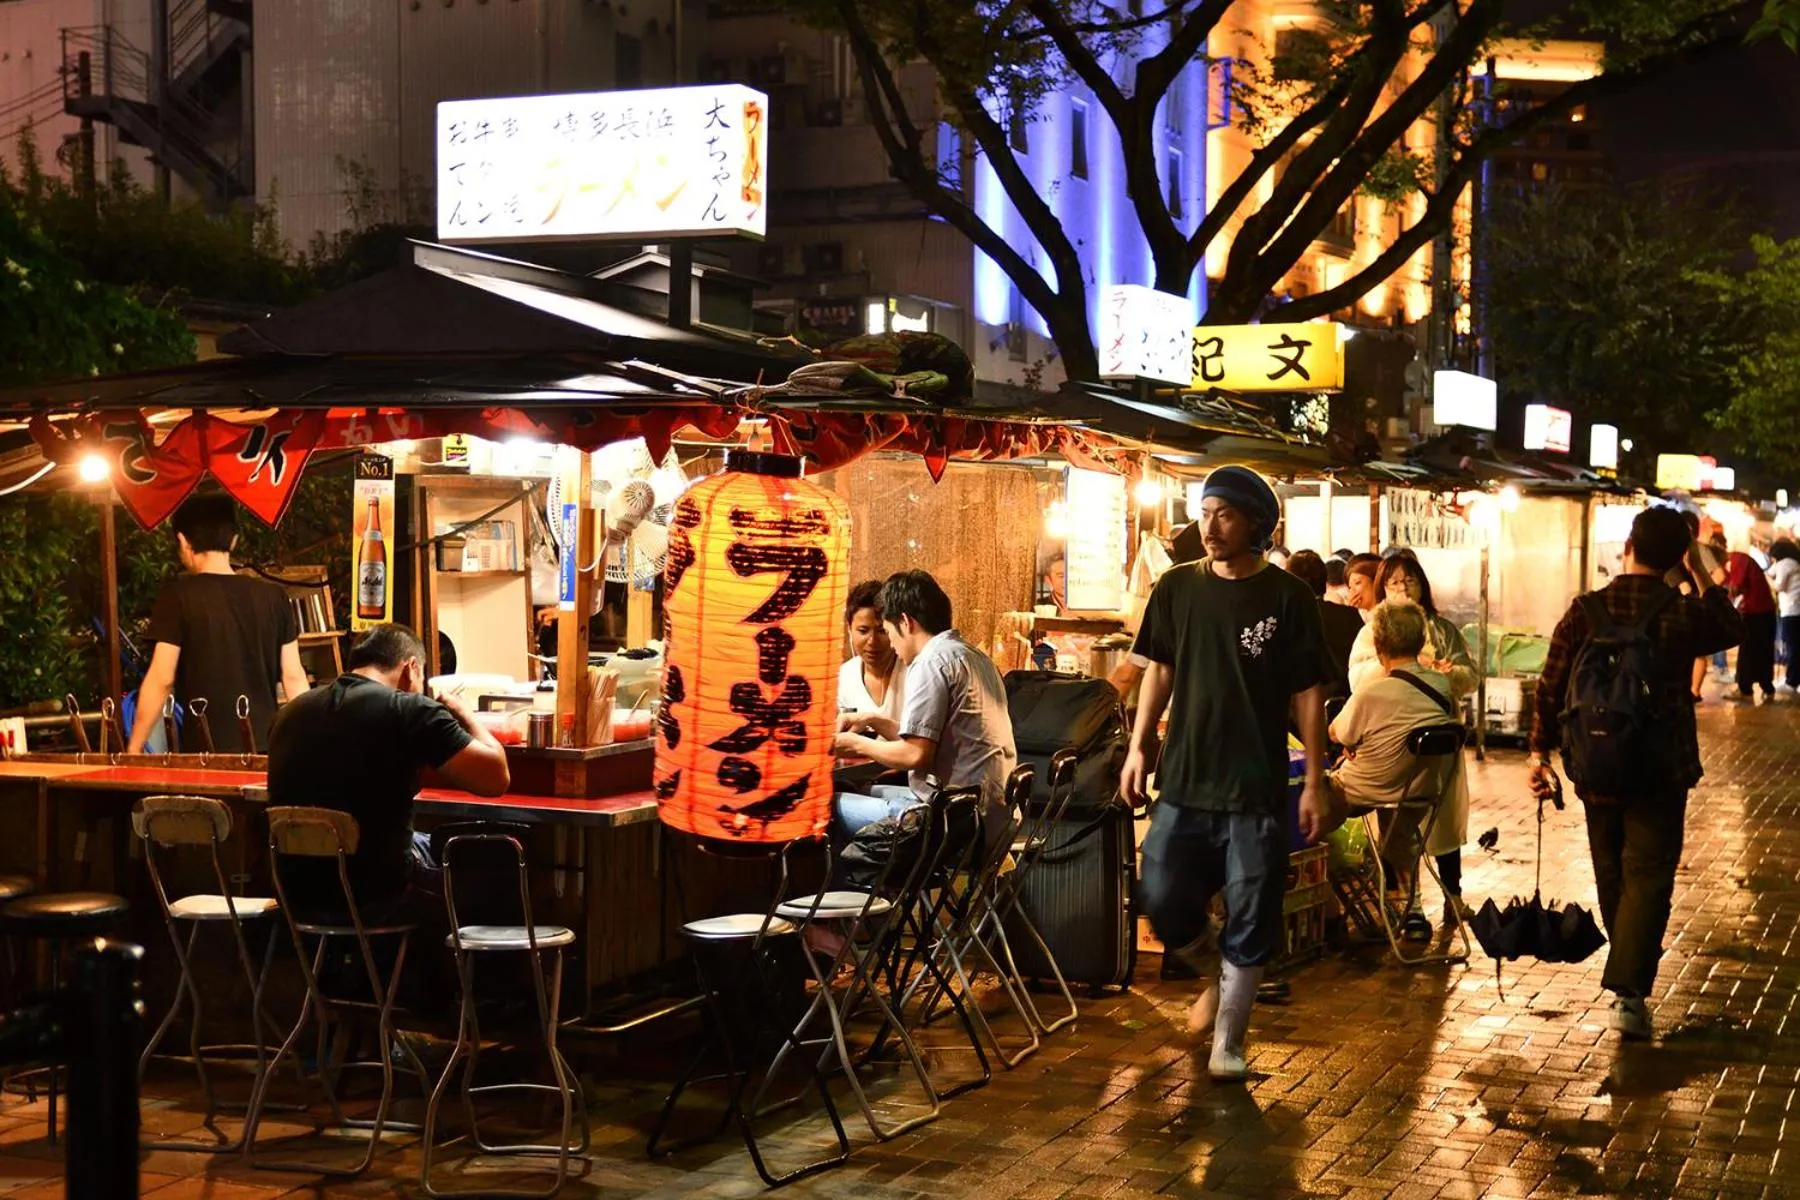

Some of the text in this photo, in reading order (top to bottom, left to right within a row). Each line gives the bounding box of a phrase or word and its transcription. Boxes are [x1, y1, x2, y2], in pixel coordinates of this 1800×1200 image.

[533, 153, 690, 228] ラーメン
[702, 98, 731, 223] 大ちゃん
[743, 100, 760, 221] ラーメン
[1107, 291, 1128, 373] ラーメン
[360, 461, 389, 477] No.1
[706, 506, 832, 838] ラーメン
